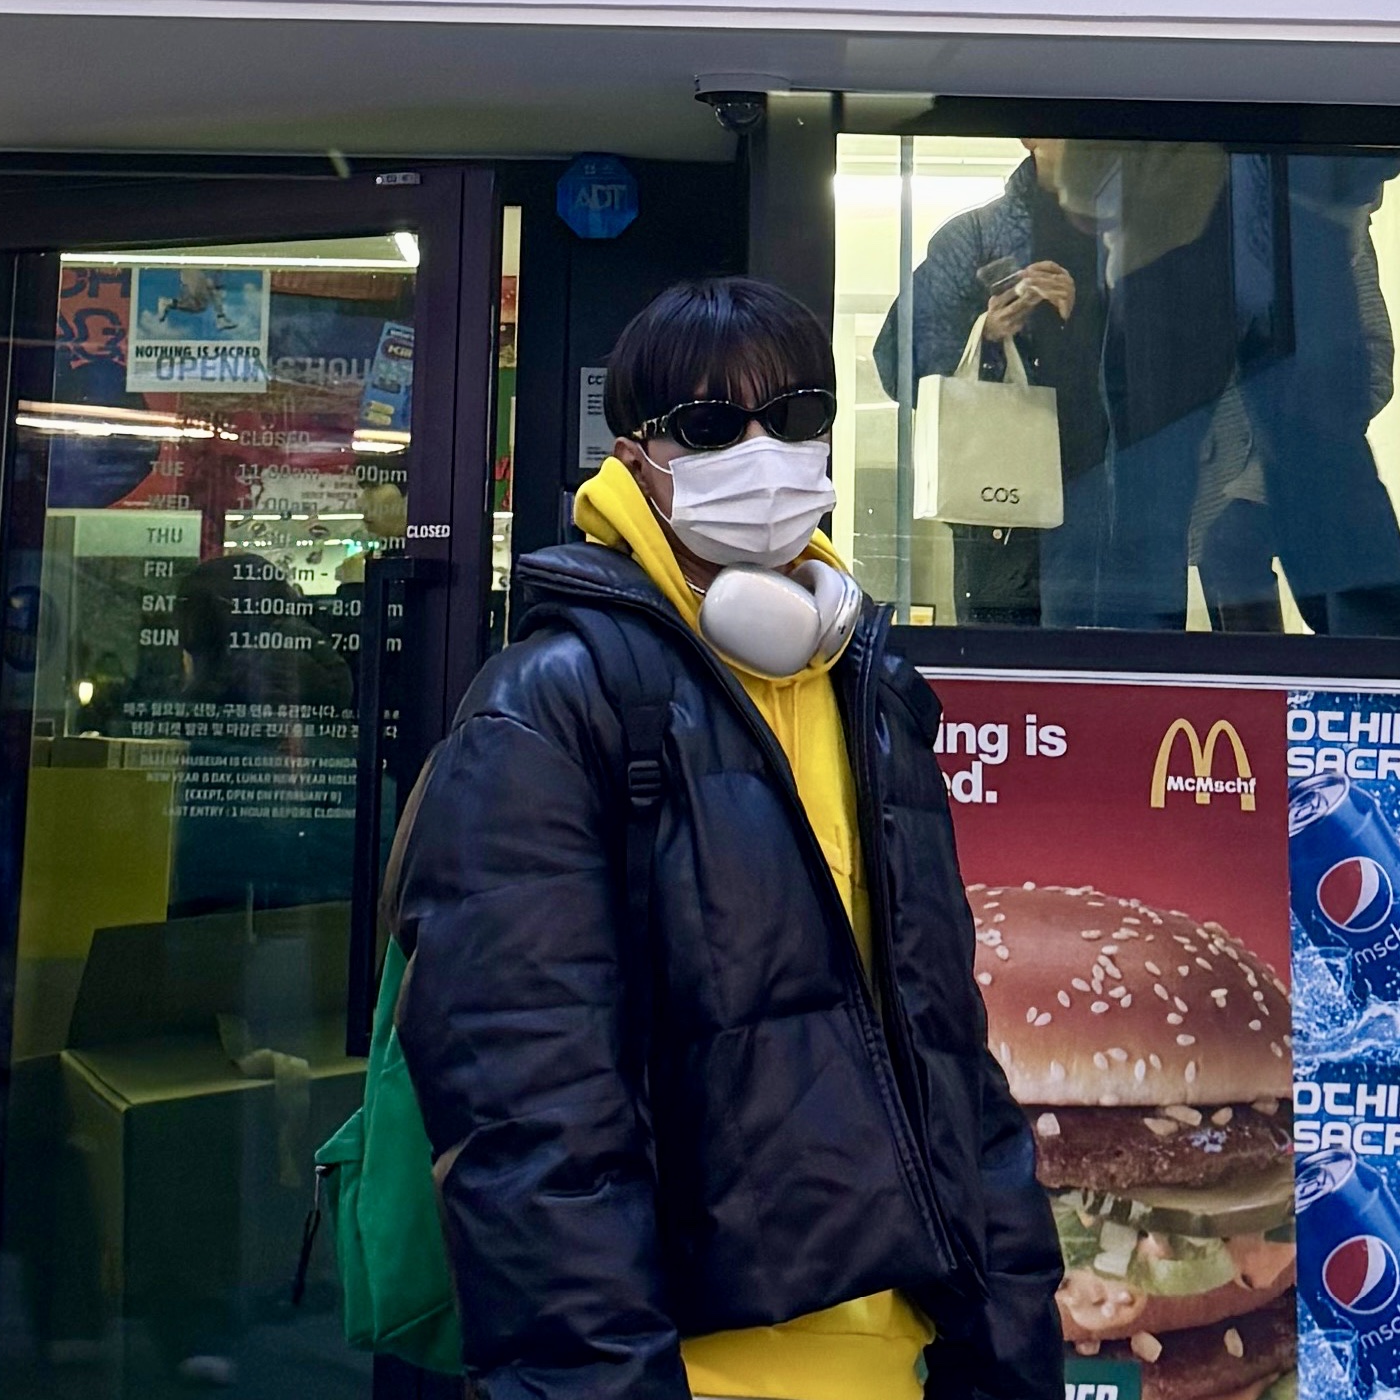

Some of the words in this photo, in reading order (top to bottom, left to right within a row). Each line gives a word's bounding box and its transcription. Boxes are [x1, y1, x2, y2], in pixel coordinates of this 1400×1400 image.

[576, 184, 627, 209] ADT
[135, 345, 193, 359] NOTHING
[980, 486, 1020, 504] COS
[145, 527, 183, 543] THU
[406, 524, 450, 539] CLOSED
[143, 561, 174, 578] FRI
[141, 595, 177, 612] SAT
[230, 598, 314, 617] 11:00am
[139, 629, 180, 646] SUN
[228, 631, 313, 651] 11:00am
[1025, 713, 1068, 758] is
[1166, 775, 1257, 795] McMschf
